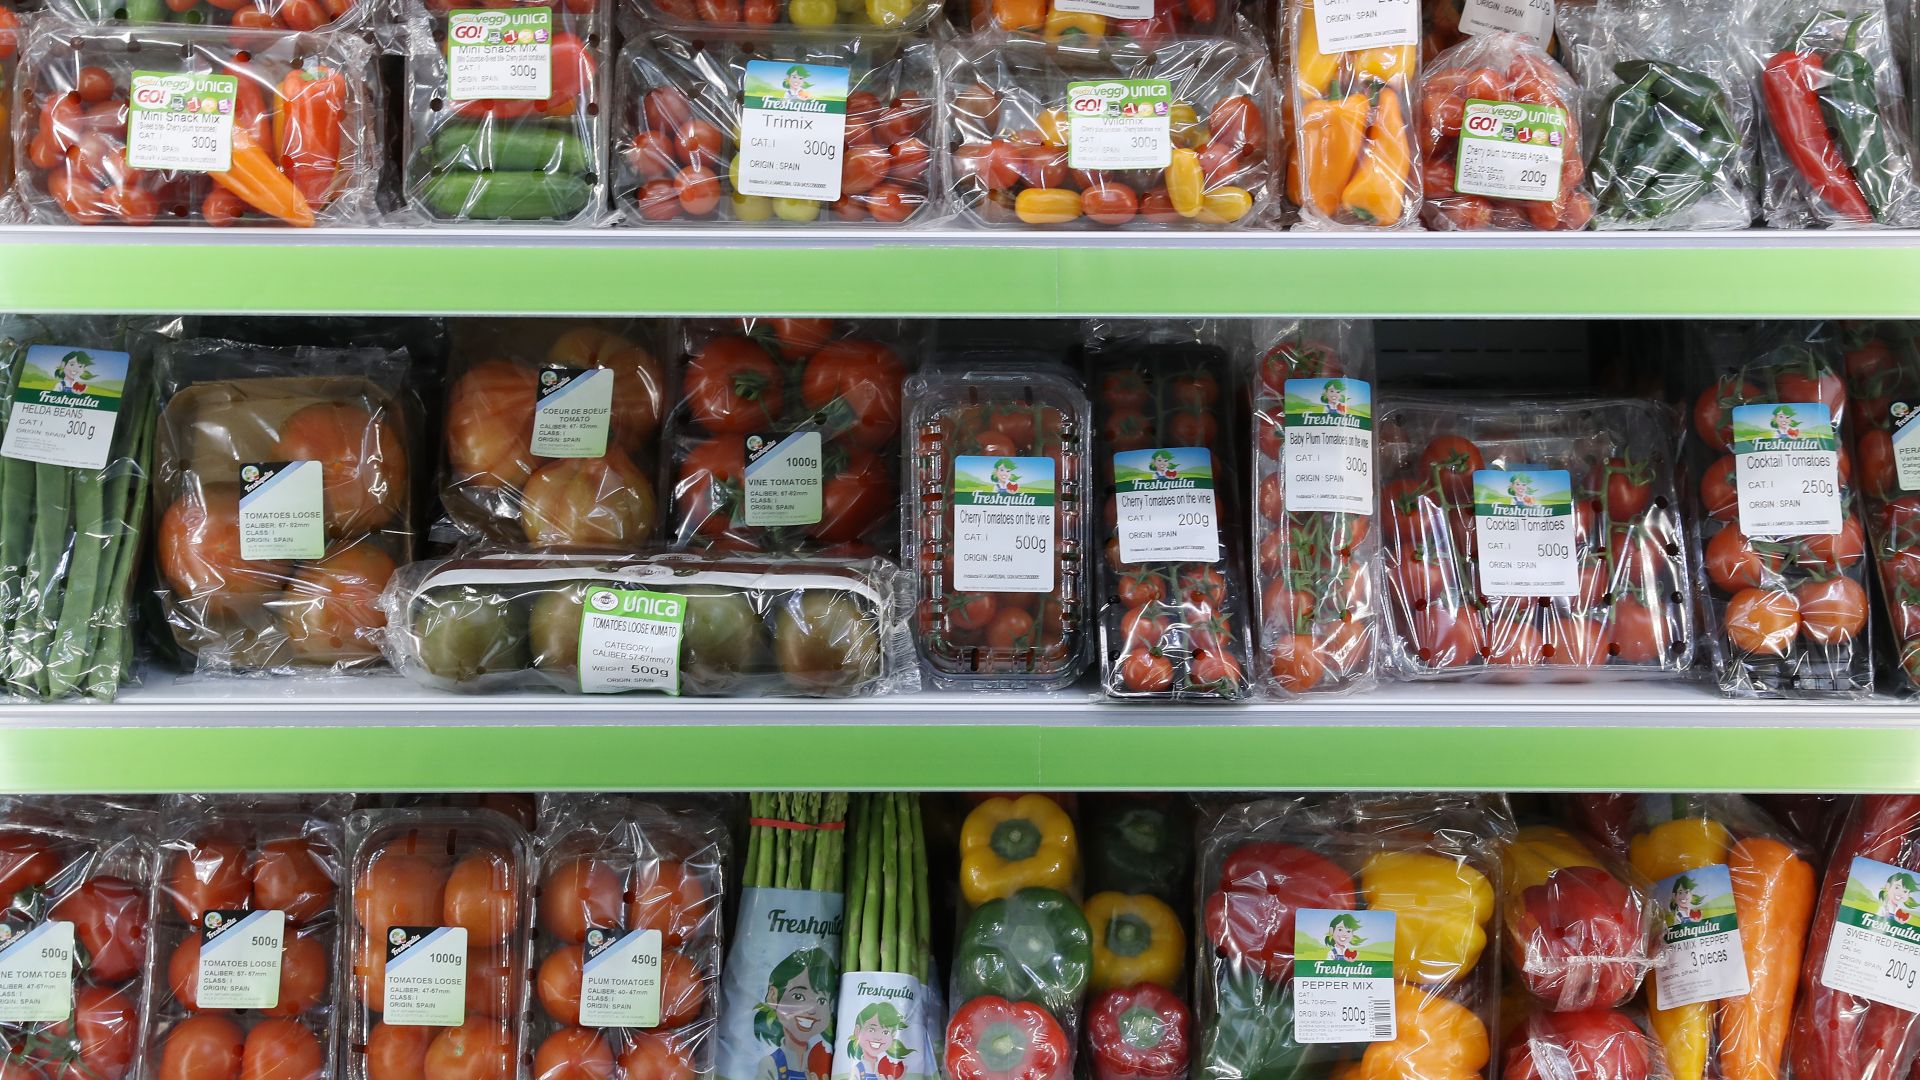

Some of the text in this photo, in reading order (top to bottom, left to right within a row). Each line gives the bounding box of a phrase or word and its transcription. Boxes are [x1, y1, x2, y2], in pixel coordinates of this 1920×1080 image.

[1326, 10, 1377, 24] ORIGIN SPAIN
[1504, 6, 1524, 17] SPAIN
[477, 16, 506, 26] veggi
[455, 26, 482, 38] GO!
[458, 44, 537, 54] Mini Snack Mix
[511, 65, 536, 79] 300g
[138, 89, 166, 104] GO!
[1095, 87, 1124, 98] veggi
[1074, 99, 1101, 112] GO!
[141, 112, 220, 123] Mini Snack Mix
[1492, 108, 1523, 120] veggi
[762, 114, 814, 129] Trimix
[1469, 116, 1498, 131] GO!
[192, 136, 217, 152] 300g
[804, 140, 836, 160] 300g
[1131, 136, 1158, 151] 300g
[750, 160, 800, 171] ORIGIN SPAIN
[1521, 170, 1547, 186] 200g
[21, 404, 83, 419] HELDA BEANS
[66, 420, 95, 440] 300 g
[1290, 433, 1304, 447] Baby
[1306, 433, 1320, 445] Plum
[1322, 433, 1348, 446] Tomatoes
[787, 457, 817, 469] 1000g
[1346, 456, 1367, 477] 300g
[1747, 454, 1831, 470] Cocktail Tomatoes
[1295, 474, 1344, 483] ORIGIN SPAIN
[1802, 480, 1833, 497] 250g
[1122, 493, 1211, 509] Cherry Tomatoes on the vine
[1749, 500, 1801, 509] ORIGIN SPAIN
[293, 511, 320, 519] LOOSE
[960, 509, 981, 527] Cherry
[983, 510, 1014, 525] Tomatoes
[1016, 514, 1024, 525] on
[1025, 512, 1035, 525] the
[1178, 512, 1209, 527] 200g
[1486, 517, 1565, 531] Cocktail Tomatoes
[1129, 531, 1153, 540] ORIGIN
[1015, 535, 1046, 554] 500g
[1537, 543, 1569, 560] 500g
[964, 554, 1013, 562] ORIGIN SPAIN
[1517, 561, 1537, 569] SPAIN
[592, 617, 676, 638] TOMATOES LOOSE KUMATO
[605, 641, 650, 653] CATEGORY
[631, 664, 669, 680] 500g
[252, 936, 278, 948] 500g
[1684, 940, 1697, 951] MIX
[1700, 933, 1729, 947] PEPPER
[1846, 927, 1874, 941] SWEET
[1875, 936, 1892, 948] RED
[41, 948, 68, 961] 500g
[430, 953, 462, 966] 1000g
[632, 954, 657, 966] 450g
[1691, 949, 1728, 969] 3 pieces
[17, 971, 67, 979] TOMATOES
[1885, 958, 1908, 981] 200
[612, 978, 655, 986] TOMATOES
[1302, 981, 1374, 990] PEPPER MIX
[1341, 1007, 1366, 1025] 500g
